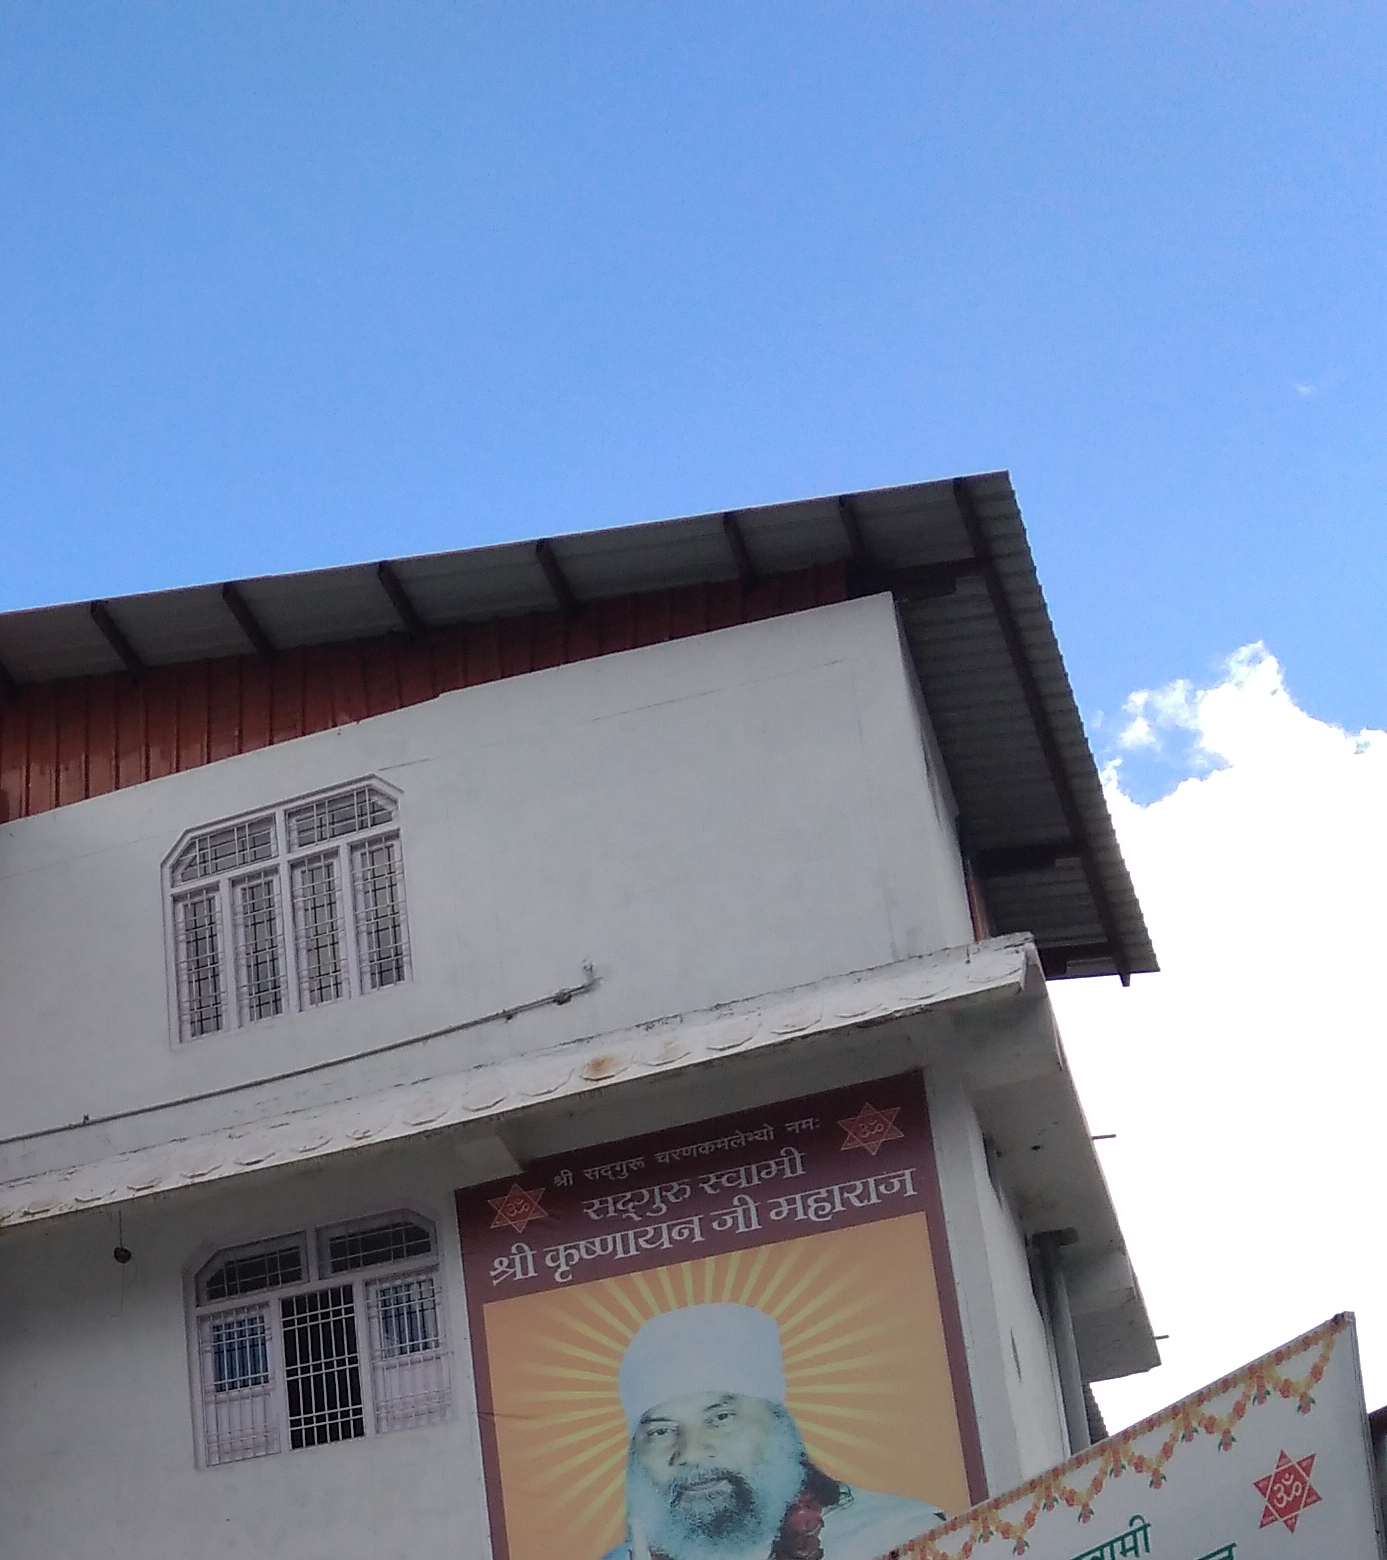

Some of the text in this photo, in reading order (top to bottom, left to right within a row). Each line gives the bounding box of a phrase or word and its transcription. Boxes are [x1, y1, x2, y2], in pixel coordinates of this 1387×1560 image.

[553, 1168, 574, 1188] श्री
[785, 1117, 821, 1135] नमः
[581, 1146, 806, 1222] सद्गुरु स्वामी
[489, 1167, 919, 1286] श्री कृष्णायन जी महाराज
[1271, 1470, 1304, 1511] ॐ
